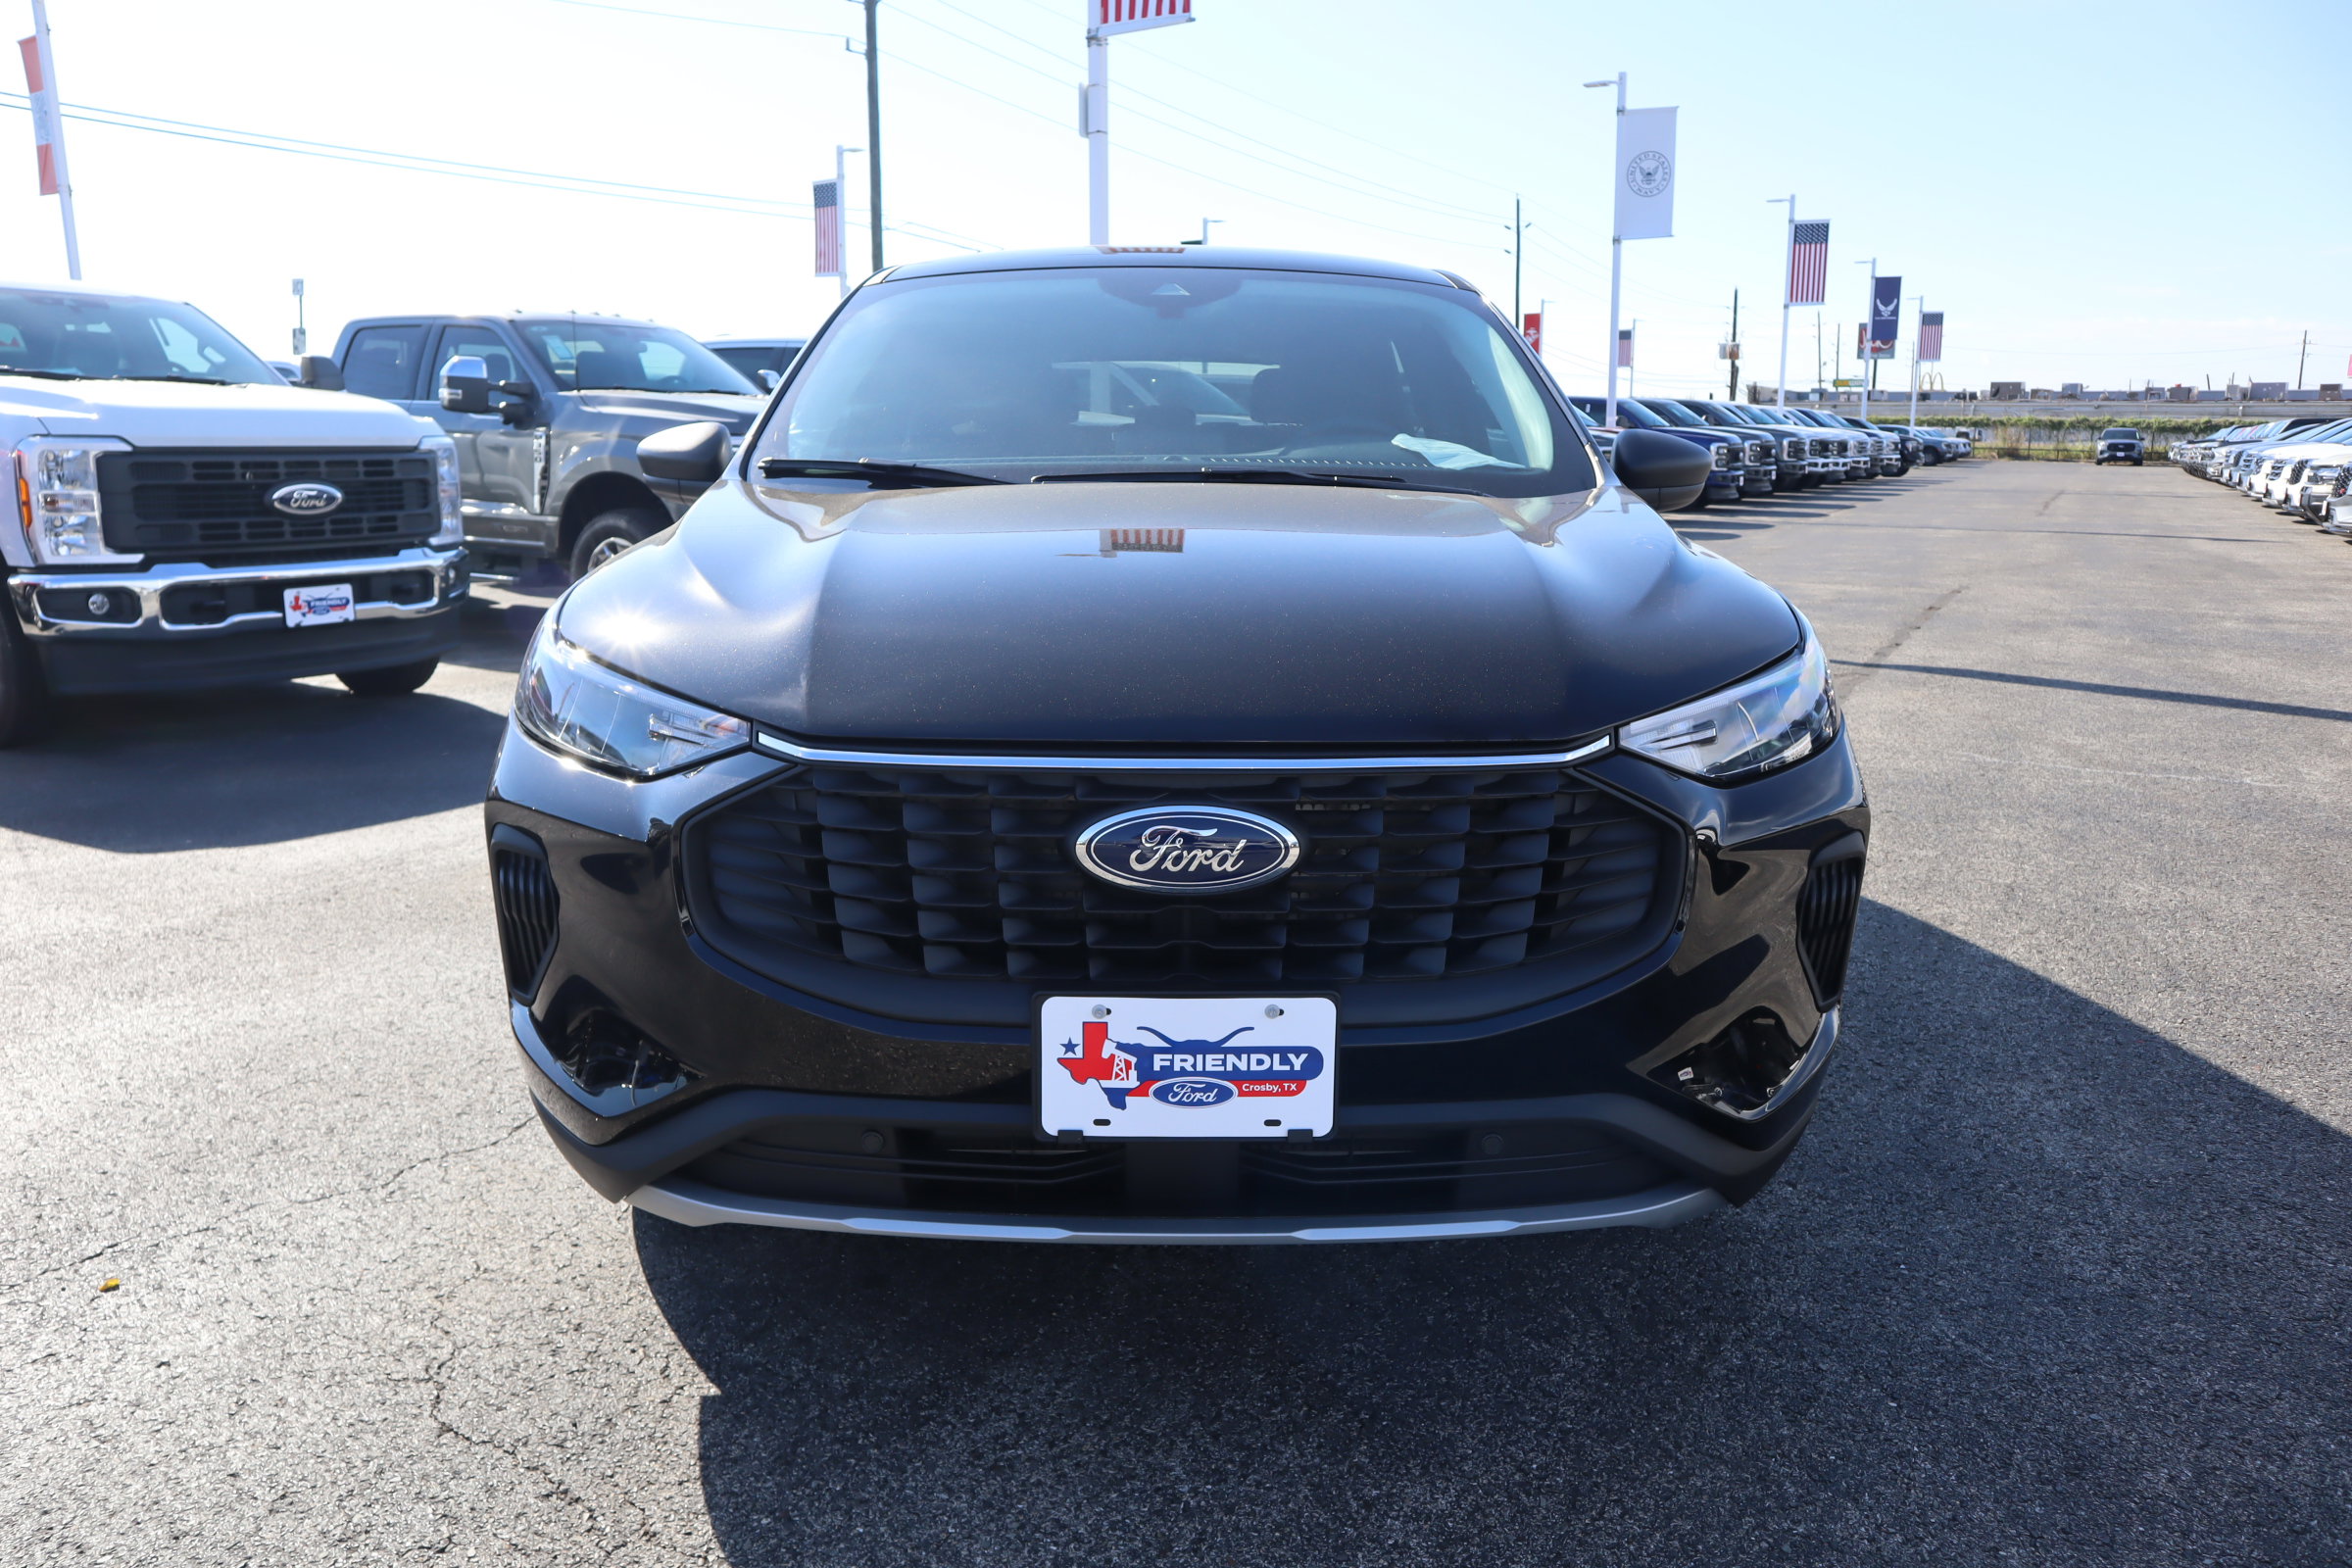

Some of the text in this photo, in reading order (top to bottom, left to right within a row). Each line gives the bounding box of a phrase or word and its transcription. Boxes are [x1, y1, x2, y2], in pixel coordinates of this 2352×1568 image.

[1637, 186, 1660, 195] NAVY
[290, 490, 327, 508] Ford
[1129, 824, 1247, 872] Ford
[1152, 1053, 1308, 1072] FRIENDLY
[1167, 1082, 1217, 1102] Ford
[1242, 1083, 1298, 1093] Crosby, TX
